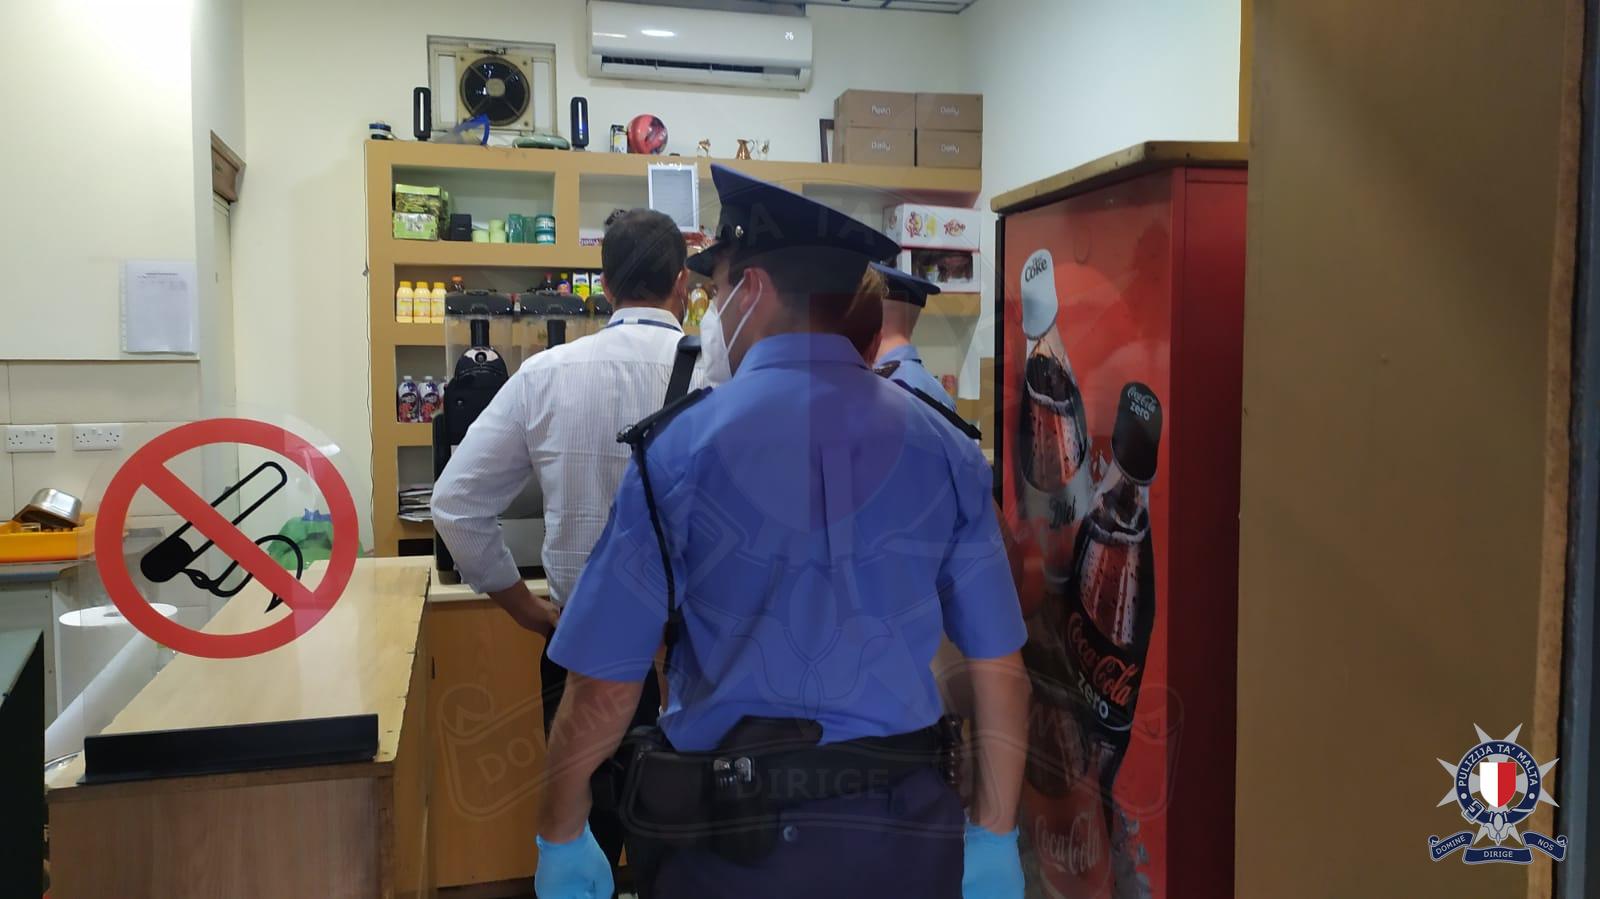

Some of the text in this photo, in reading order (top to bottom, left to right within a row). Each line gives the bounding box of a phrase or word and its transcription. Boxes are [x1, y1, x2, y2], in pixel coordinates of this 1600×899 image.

[1024, 257, 1048, 283] Coke
[1130, 400, 1150, 421] zero
[1078, 671, 1109, 720] zero
